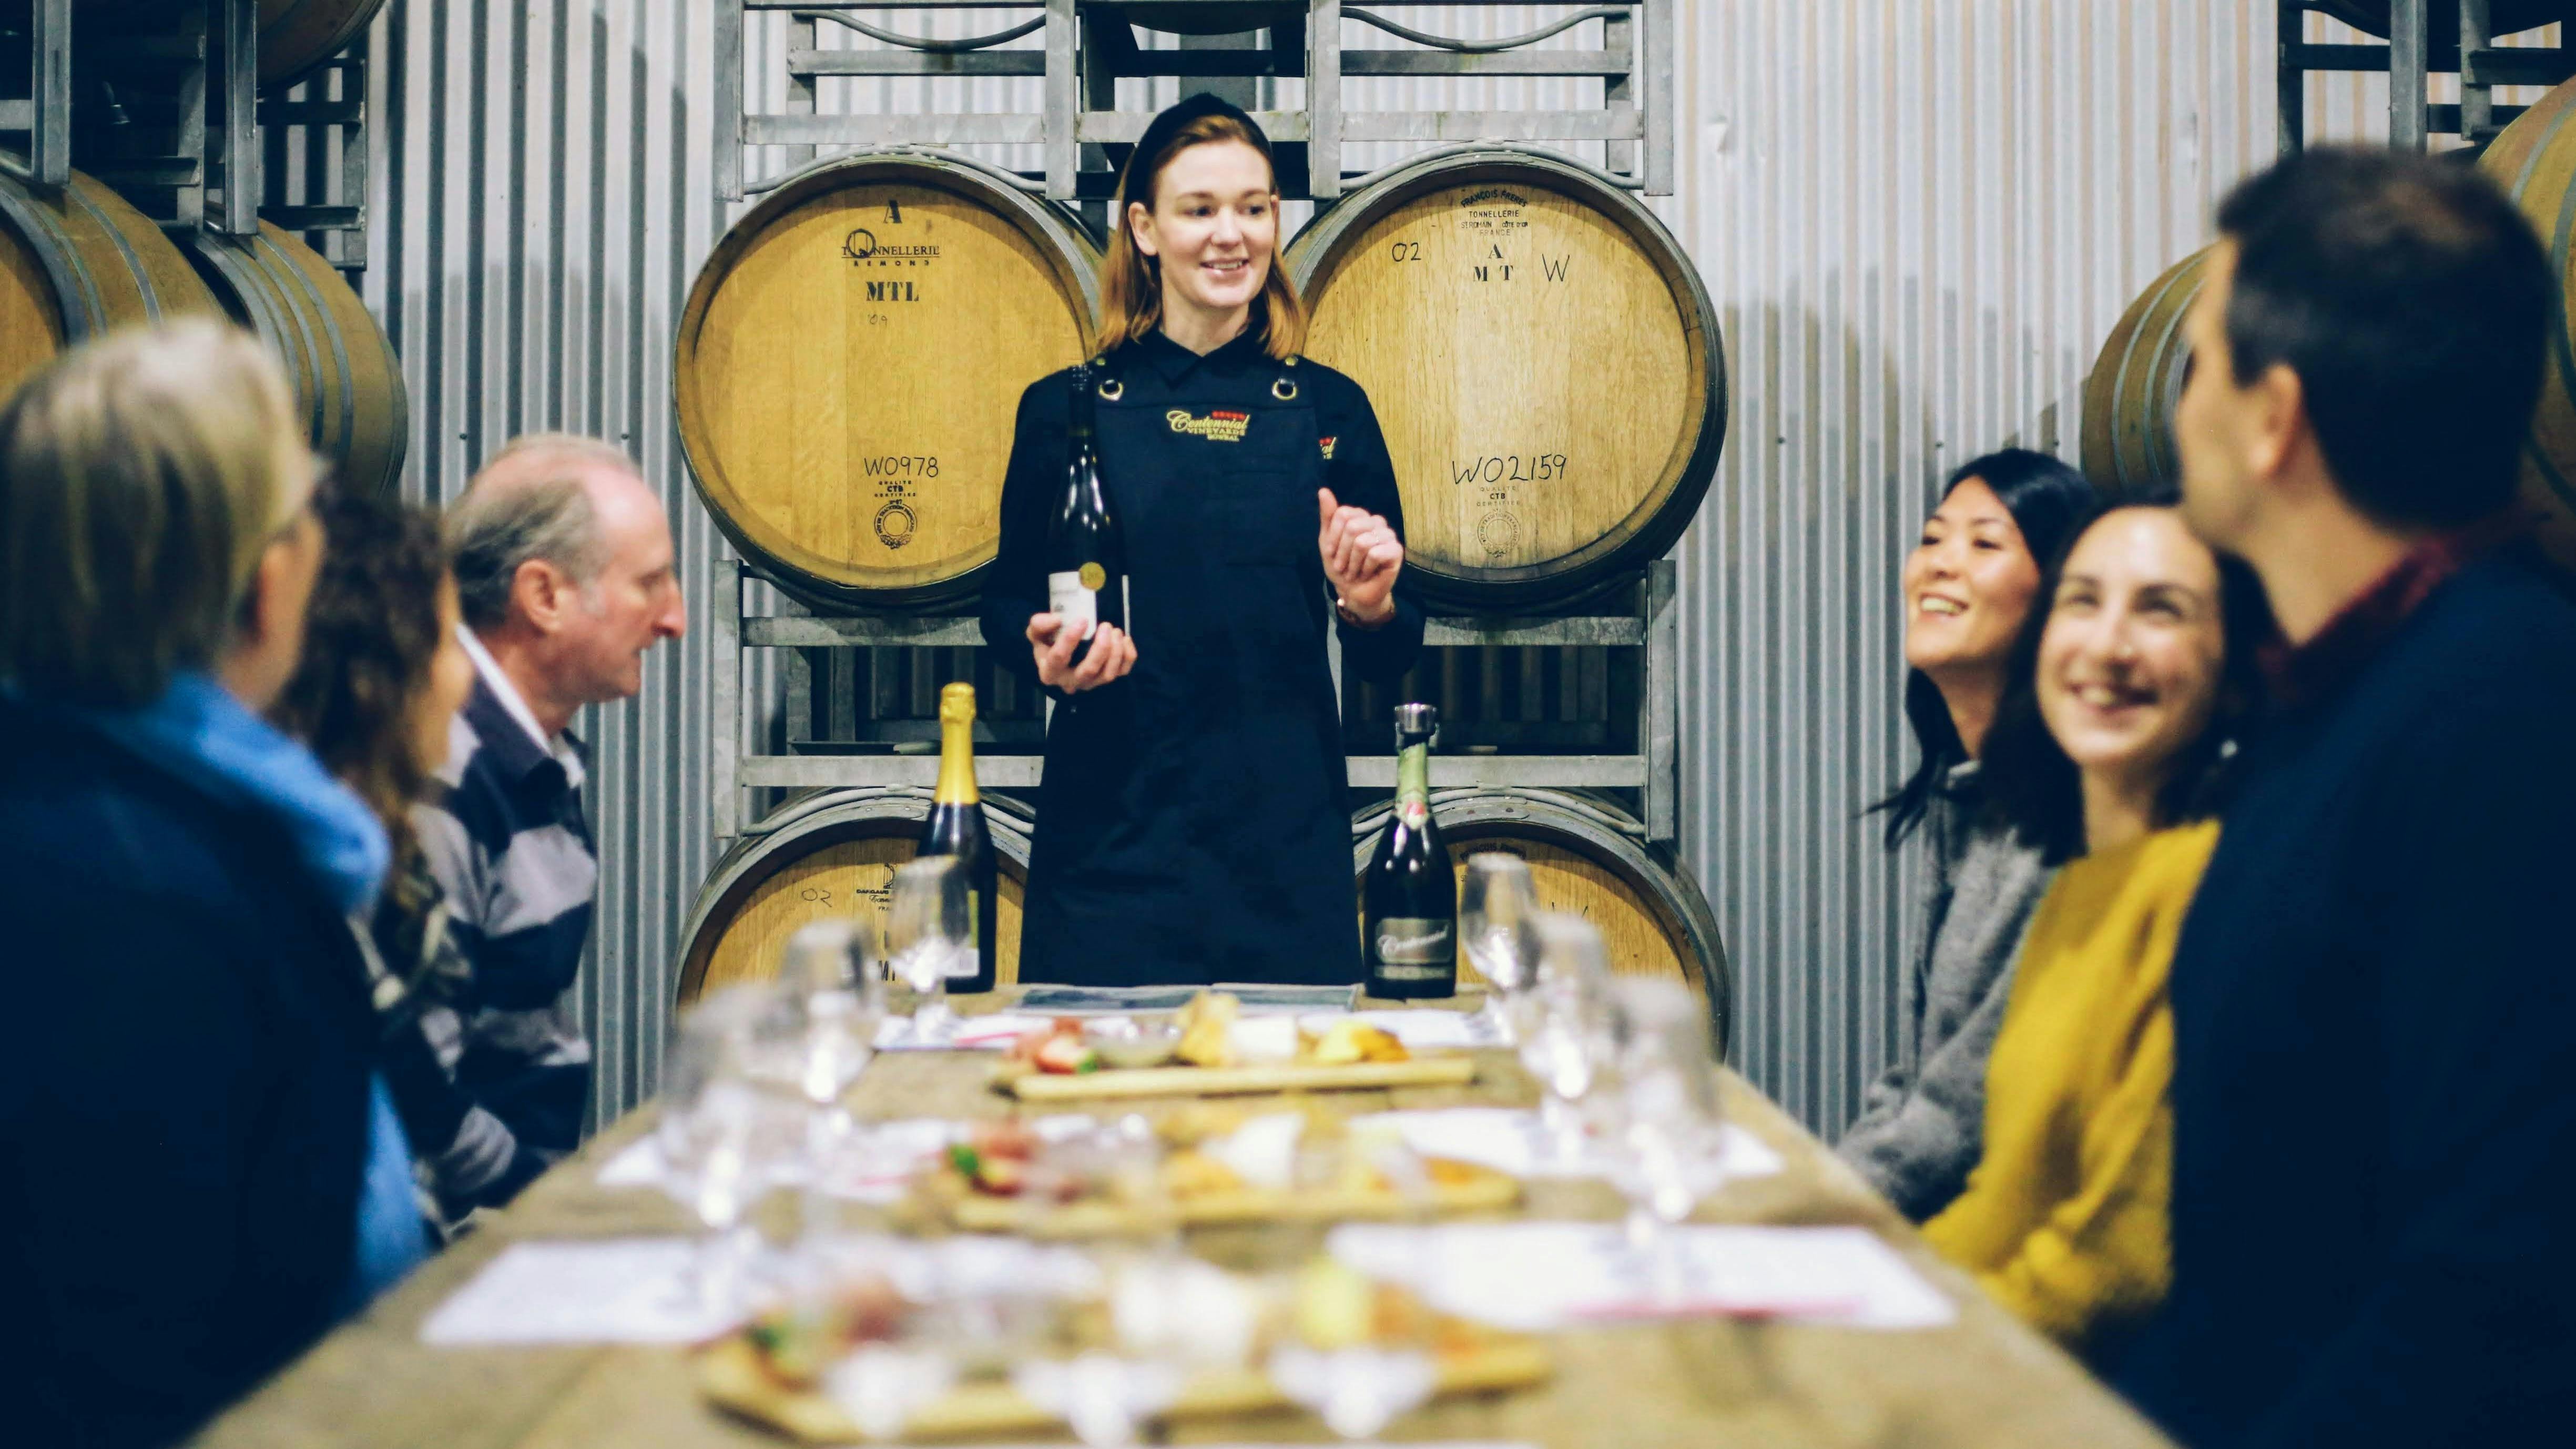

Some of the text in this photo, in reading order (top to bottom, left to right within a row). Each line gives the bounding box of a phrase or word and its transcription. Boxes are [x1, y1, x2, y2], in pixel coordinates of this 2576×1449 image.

[883, 199, 902, 224] A
[1392, 242, 1422, 262] 02
[1488, 244, 1503, 259] A
[1542, 254, 1570, 282] W
[866, 281, 919, 301] MTL
[1166, 410, 1250, 432] Centennial
